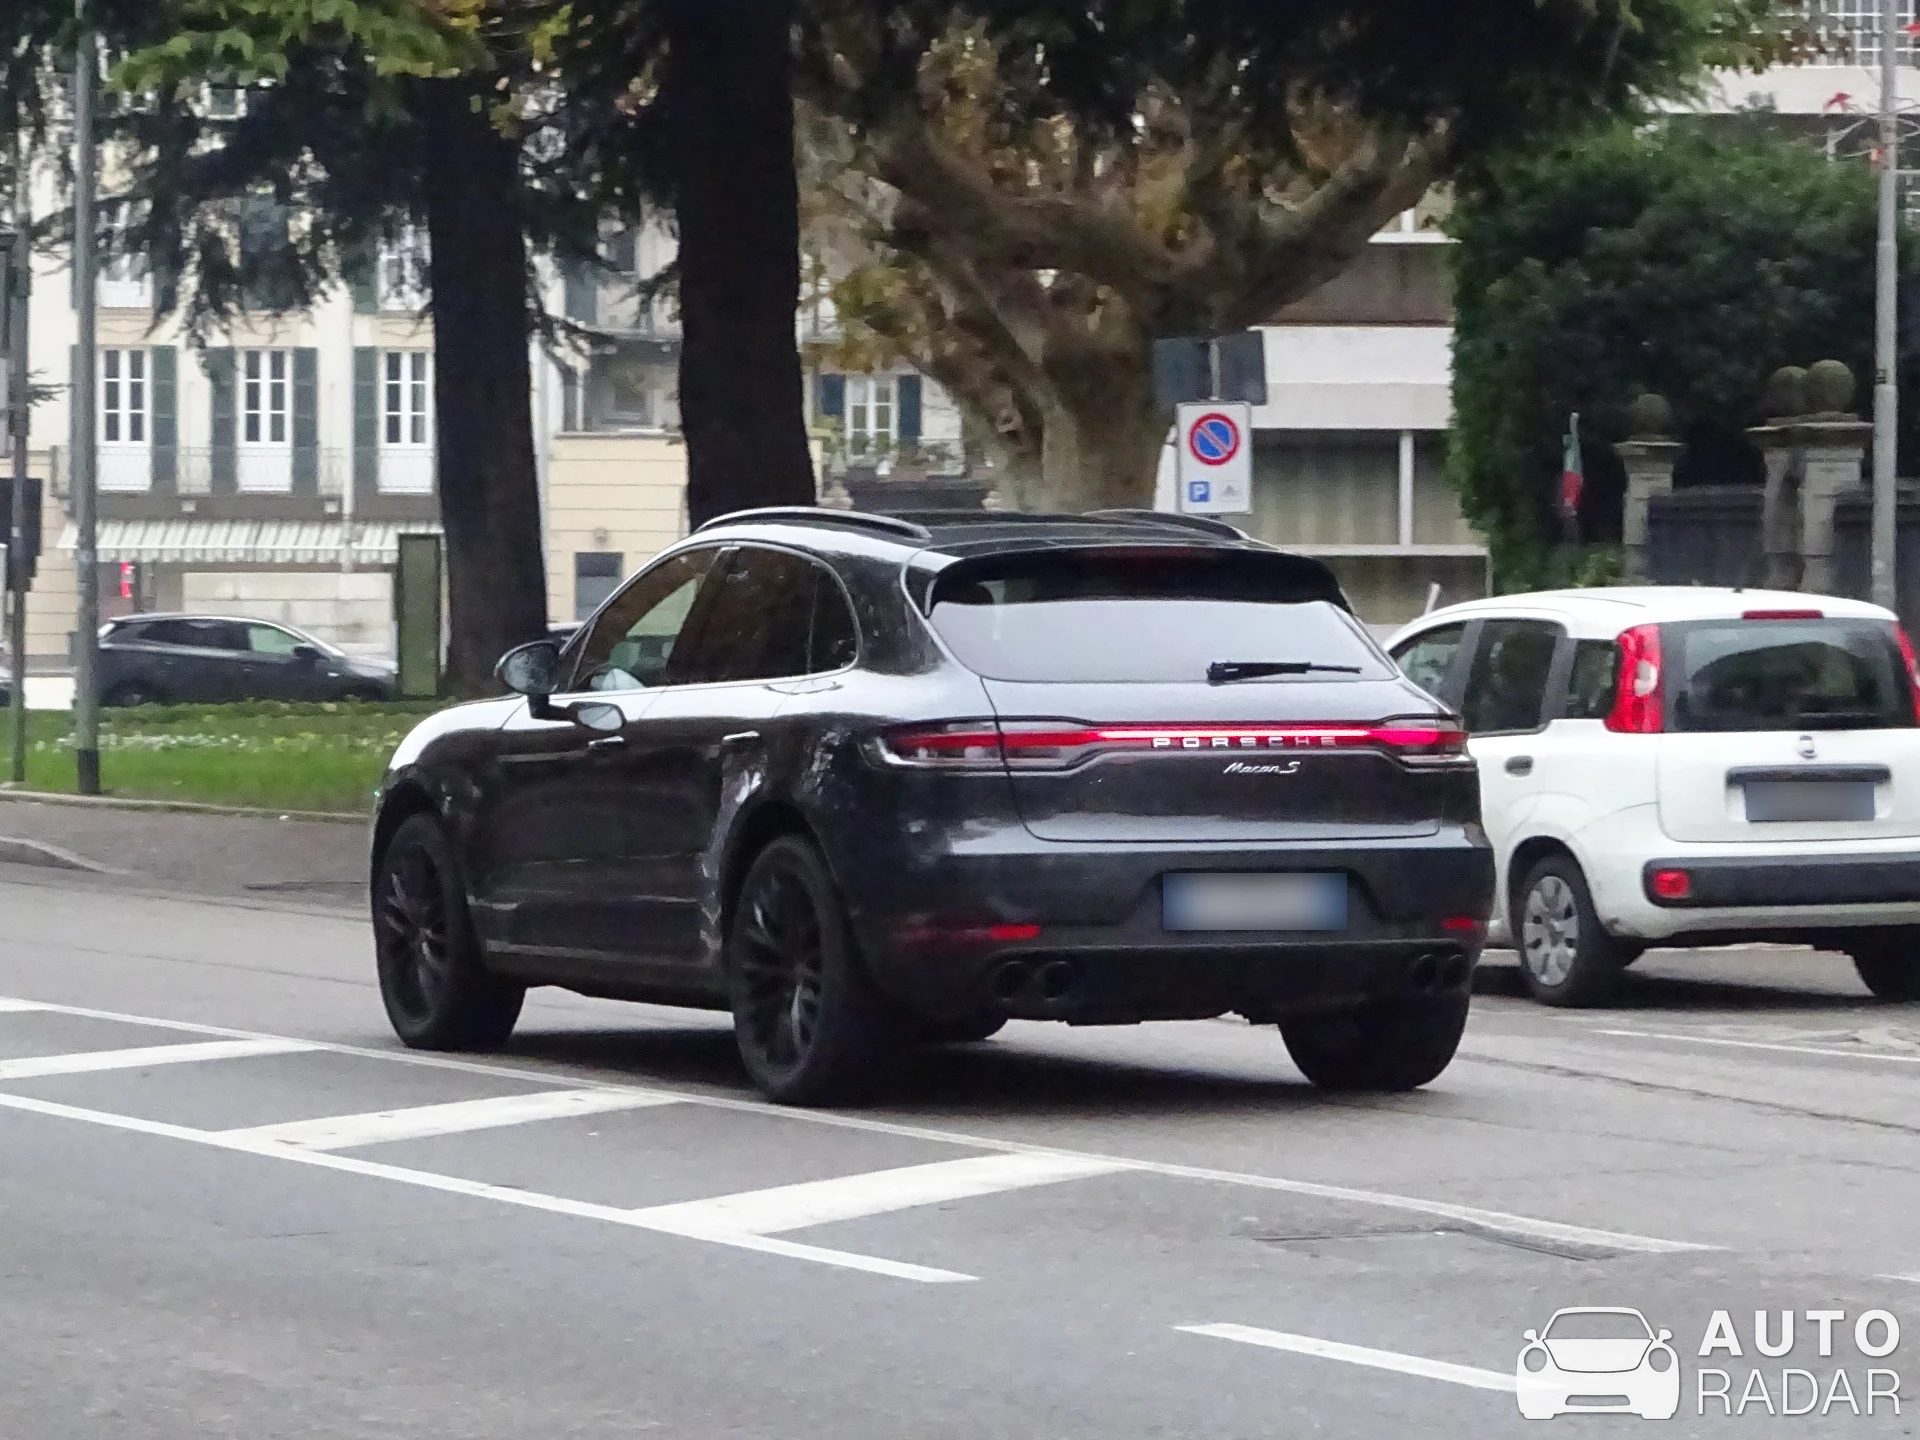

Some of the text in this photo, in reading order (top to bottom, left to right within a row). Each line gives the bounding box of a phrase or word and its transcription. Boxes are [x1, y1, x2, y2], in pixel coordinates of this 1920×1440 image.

[1193, 484, 1205, 499] P
[1153, 736, 1337, 748] PORSCHE
[1223, 761, 1301, 774] Macan S
